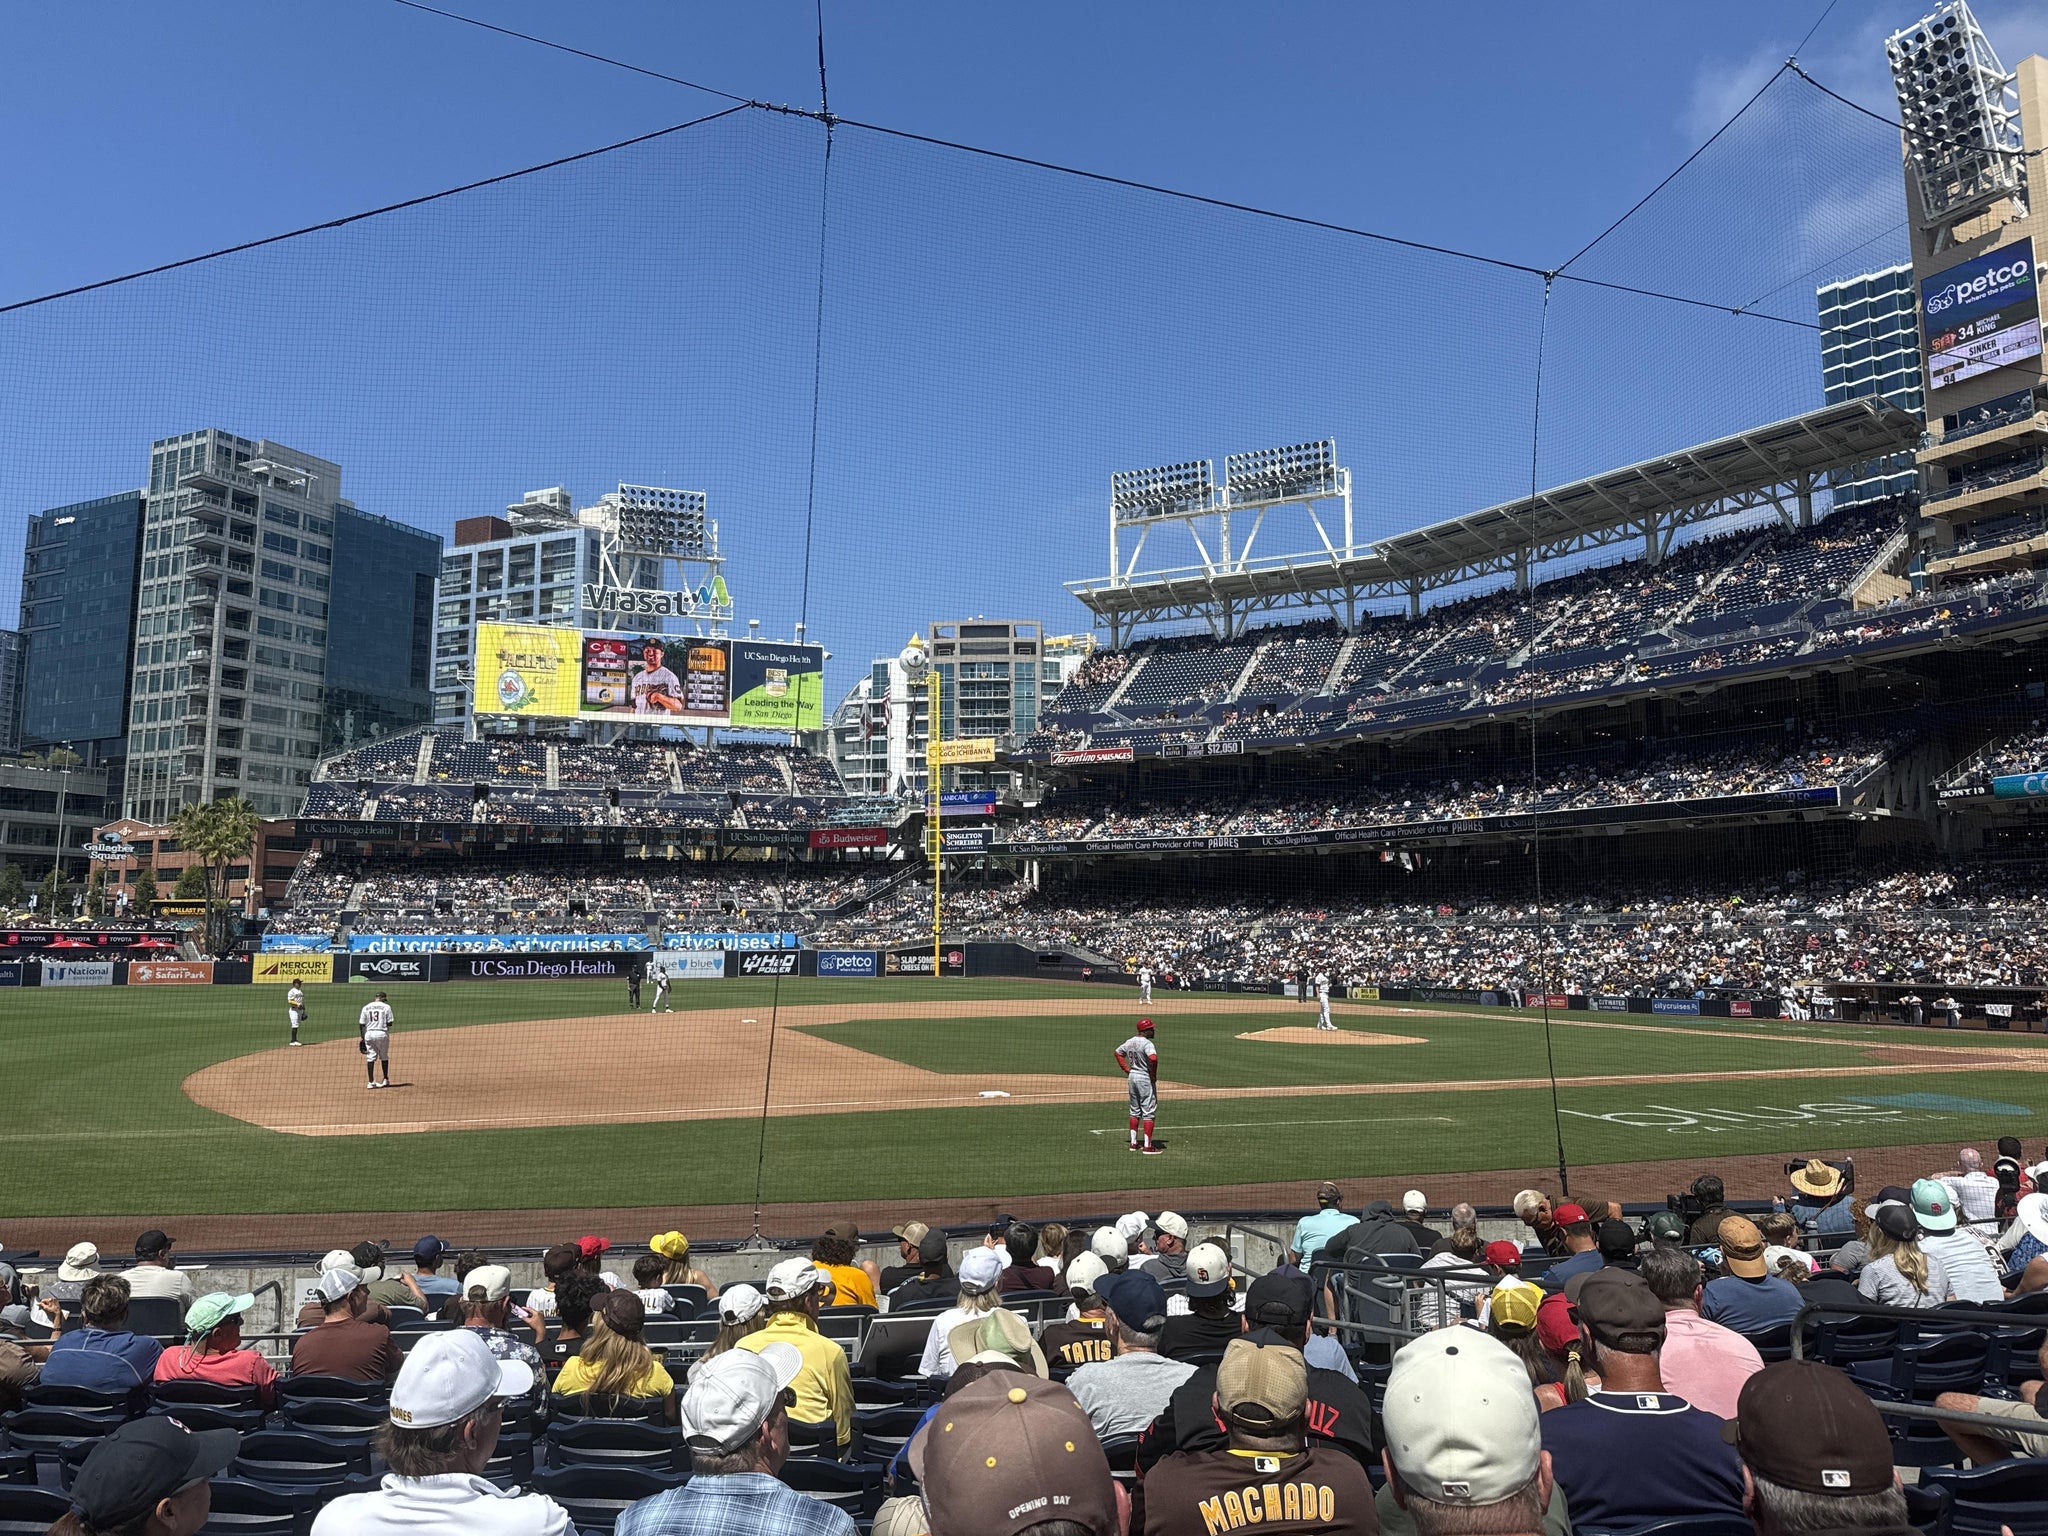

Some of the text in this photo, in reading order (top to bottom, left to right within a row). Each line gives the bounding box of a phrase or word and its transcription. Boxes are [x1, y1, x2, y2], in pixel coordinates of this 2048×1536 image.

[1957, 261, 2027, 304] petco
[1965, 282, 2015, 304] where the pets
[1975, 313, 2001, 327] MICHAEL
[1958, 324, 1974, 340] 34
[1976, 321, 1996, 335] KING
[1969, 339, 1997, 356] SINKER
[1943, 373, 1956, 385] 94
[586, 583, 688, 616] Viasat
[744, 651, 755, 660] UC
[756, 652, 769, 660] San
[770, 653, 789, 663] Diego
[745, 698, 779, 709] Leading
[781, 700, 795, 708] the
[744, 709, 792, 720] in San Diego
[957, 748, 991, 756] ICHIBANYA
[1207, 742, 1238, 754] $12,050
[1052, 752, 1131, 764] Tarantino SAUSAGES
[1939, 788, 1972, 798] SONY
[305, 823, 394, 836] UC San Diego Health
[1499, 819, 1513, 829] UC
[1513, 819, 1527, 828] San
[1334, 820, 1484, 841] Official Health Care Provider of the PADRES
[730, 833, 743, 842] UC
[744, 833, 758, 842] San
[759, 833, 780, 844] Diego
[833, 833, 878, 843] Budweiser
[1262, 834, 1318, 846] UC San Diego Health
[83, 843, 136, 853] Gallagher
[1009, 844, 1067, 855] UC San Diego Health
[1086, 838, 1239, 851] Official Health Care Provider of the PADRES
[89, 850, 127, 860] Square
[669, 934, 770, 950] citycruises
[280, 961, 328, 969] MERCURY
[655, 959, 677, 968] blue
[690, 959, 713, 968] blue
[836, 954, 872, 969] petco
[918, 955, 937, 963] SOME
[68, 967, 109, 976] National
[360, 960, 420, 973] EVOTEK
[470, 960, 616, 978] UC San Diego Health
[901, 963, 920, 971] CHEESE
[921, 963, 930, 971] ON
[0, 971, 14, 979] alth
[155, 970, 206, 980] Safari Park
[1434, 990, 1479, 1000] SINGING HILLS
[1654, 1003, 1691, 1012] citycruises
[369, 1010, 380, 1022] 13
[1557, 1103, 1904, 1127] blue
[1667, 1113, 1957, 1135] CALIFORNIA
[1060, 1340, 1112, 1364] TATIS
[1309, 1399, 1340, 1438] UZ
[1008, 1495, 1071, 1520] OPENING DAY
[1198, 1482, 1335, 1536] MACHADO
